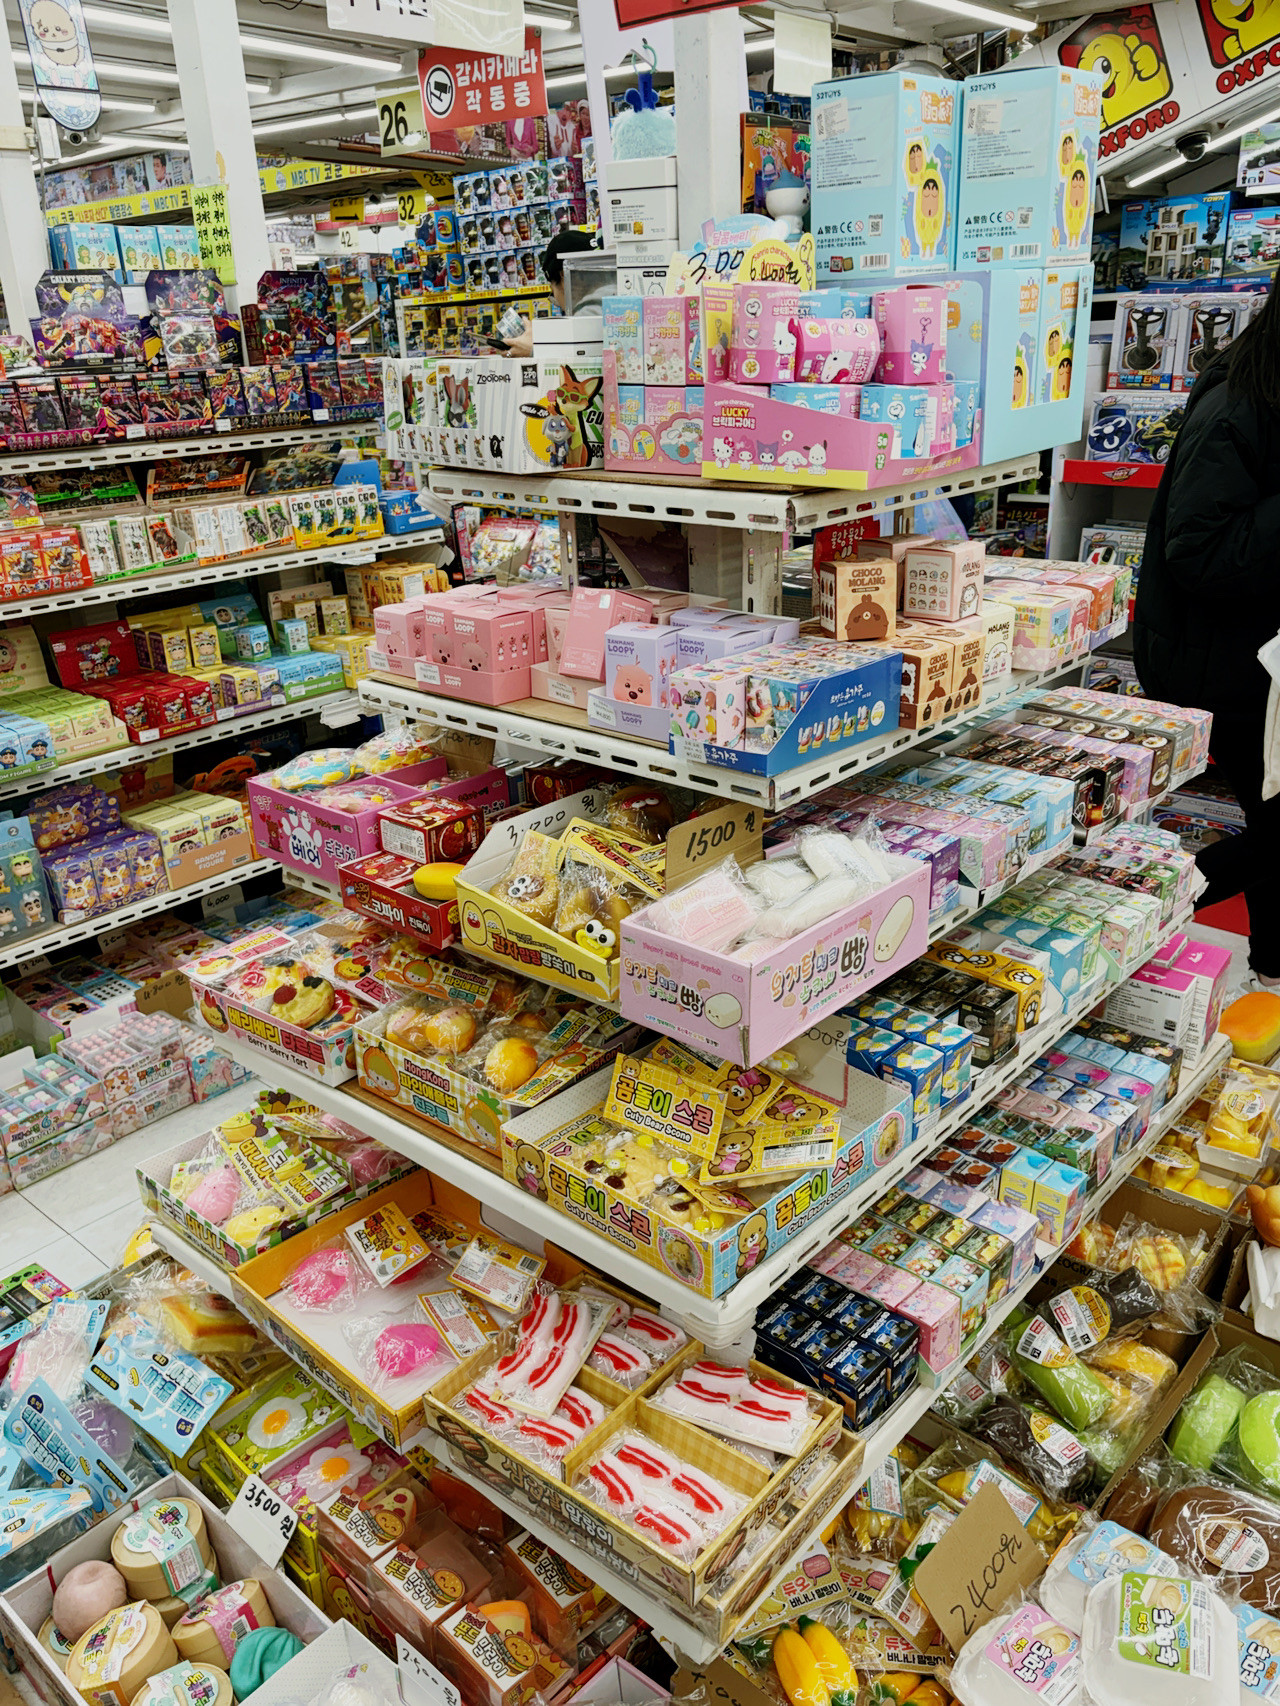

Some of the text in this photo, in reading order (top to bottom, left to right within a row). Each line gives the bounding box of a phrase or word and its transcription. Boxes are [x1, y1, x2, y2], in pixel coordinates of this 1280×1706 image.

[455, 49, 538, 87] 감시카메라
[380, 101, 409, 148] 26
[291, 170, 308, 187] MBC
[309, 167, 320, 182] TV
[153, 198, 169, 211] MBC
[169, 194, 179, 207] TV
[399, 194, 415, 221] 32
[1202, 195, 1226, 203] TOWN
[341, 230, 352, 248] 42
[50, 274, 105, 285] GALAXY VERSION
[279, 277, 308, 285] INFINITY
[477, 373, 511, 385] ZOOTOPIA
[721, 407, 750, 418] LUCKY
[712, 416, 752, 430] 브릭피규어
[848, 576, 885, 588] MOLANG
[852, 568, 882, 578] CHOCO
[376, 623, 391, 631] LOOPY
[425, 615, 445, 625] LOOPY
[454, 623, 475, 634] LOOPY
[988, 622, 1010, 634] MOLANG
[608, 639, 634, 647] ZANMANG
[608, 645, 635, 654] LOOPY
[679, 638, 704, 647] ZANMANG
[679, 645, 704, 654] LOOPY
[963, 641, 979, 652] CHOCO
[930, 653, 947, 665] CHOCO
[961, 648, 980, 660] MOLANG
[928, 662, 948, 674] MOLANG
[445, 678, 462, 687] LOOPY
[621, 711, 642, 719] ZANMANG
[622, 716, 642, 725] LOOPY
[581, 794, 597, 814] 원
[744, 810, 756, 833] 원
[194, 849, 226, 866] RANDOM
[198, 857, 225, 871] FIGURE
[491, 934, 576, 979] 감자말랑빵쑥이
[840, 932, 869, 976] 빵
[445, 975, 489, 997] 파인애플번
[453, 968, 487, 984] HongKong
[770, 950, 815, 1002] 요거트
[679, 985, 704, 1017] 빵
[228, 1005, 326, 1065] 베리베리 타르트
[248, 1034, 308, 1070] Berry Berry Tart
[404, 1058, 450, 1092] HongKong
[399, 1070, 458, 1113] 파인애플번
[412, 1095, 450, 1126] 친구들
[616, 1076, 714, 1135] 곰돌이 스콘
[625, 1107, 692, 1143] Cuty Bear Scone
[233, 1152, 248, 1171] TOKYO
[239, 1138, 274, 1182] 바나나
[288, 1172, 314, 1199] 바나나
[776, 1141, 865, 1231] 곰돌이 스콘
[549, 1164, 652, 1246] 곰돌이 스콘
[787, 1183, 850, 1236] Cuty Bear Scone
[186, 1213, 225, 1256] 바나나
[564, 1200, 637, 1249] Cuty Bear Scone
[501, 1456, 615, 1550] 삼겹살 말랑이
[280, 1515, 295, 1540] 원
[329, 1501, 377, 1548] 푸드 말랑이
[394, 1551, 415, 1568] Food
[517, 1541, 567, 1597] 푸드 말랑이
[384, 1558, 437, 1611] 푸드 말랑이
[781, 1577, 811, 1597] 듀오
[789, 1581, 842, 1608] 바나나 말랑이
[464, 1613, 487, 1630] Food
[1152, 1607, 1180, 1667] 손만두
[453, 1620, 509, 1679] 푸드 말랑이
[887, 1652, 946, 1666] 바나나 말랑이
[1014, 1642, 1052, 1684] 손만두
[1241, 1642, 1271, 1687] 손만두
